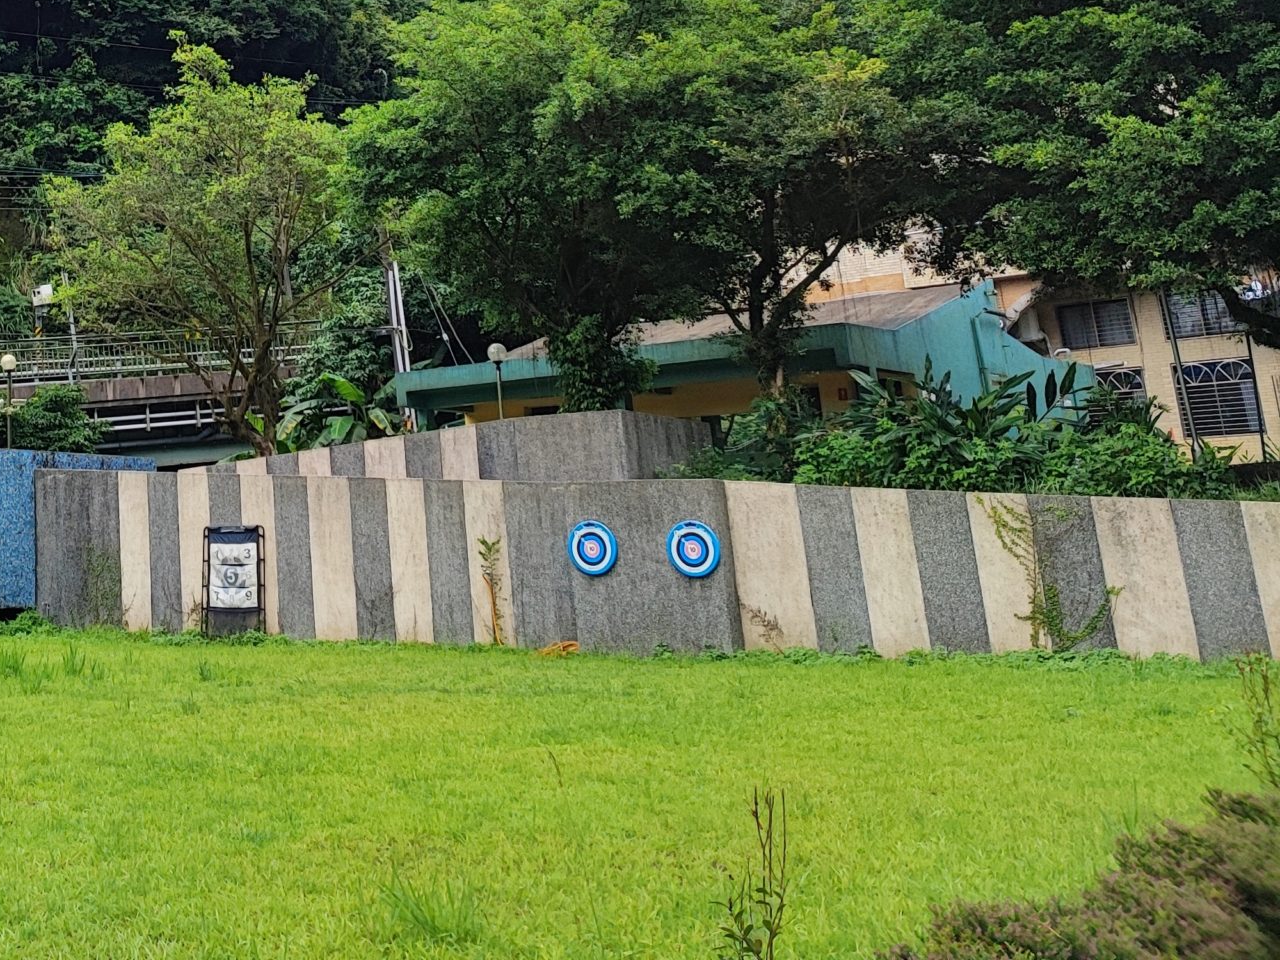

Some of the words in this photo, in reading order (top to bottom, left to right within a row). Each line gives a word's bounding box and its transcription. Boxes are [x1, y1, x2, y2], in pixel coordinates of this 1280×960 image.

[243, 548, 251, 559] 3
[227, 568, 235, 583] 5
[245, 590, 252, 601] 9
